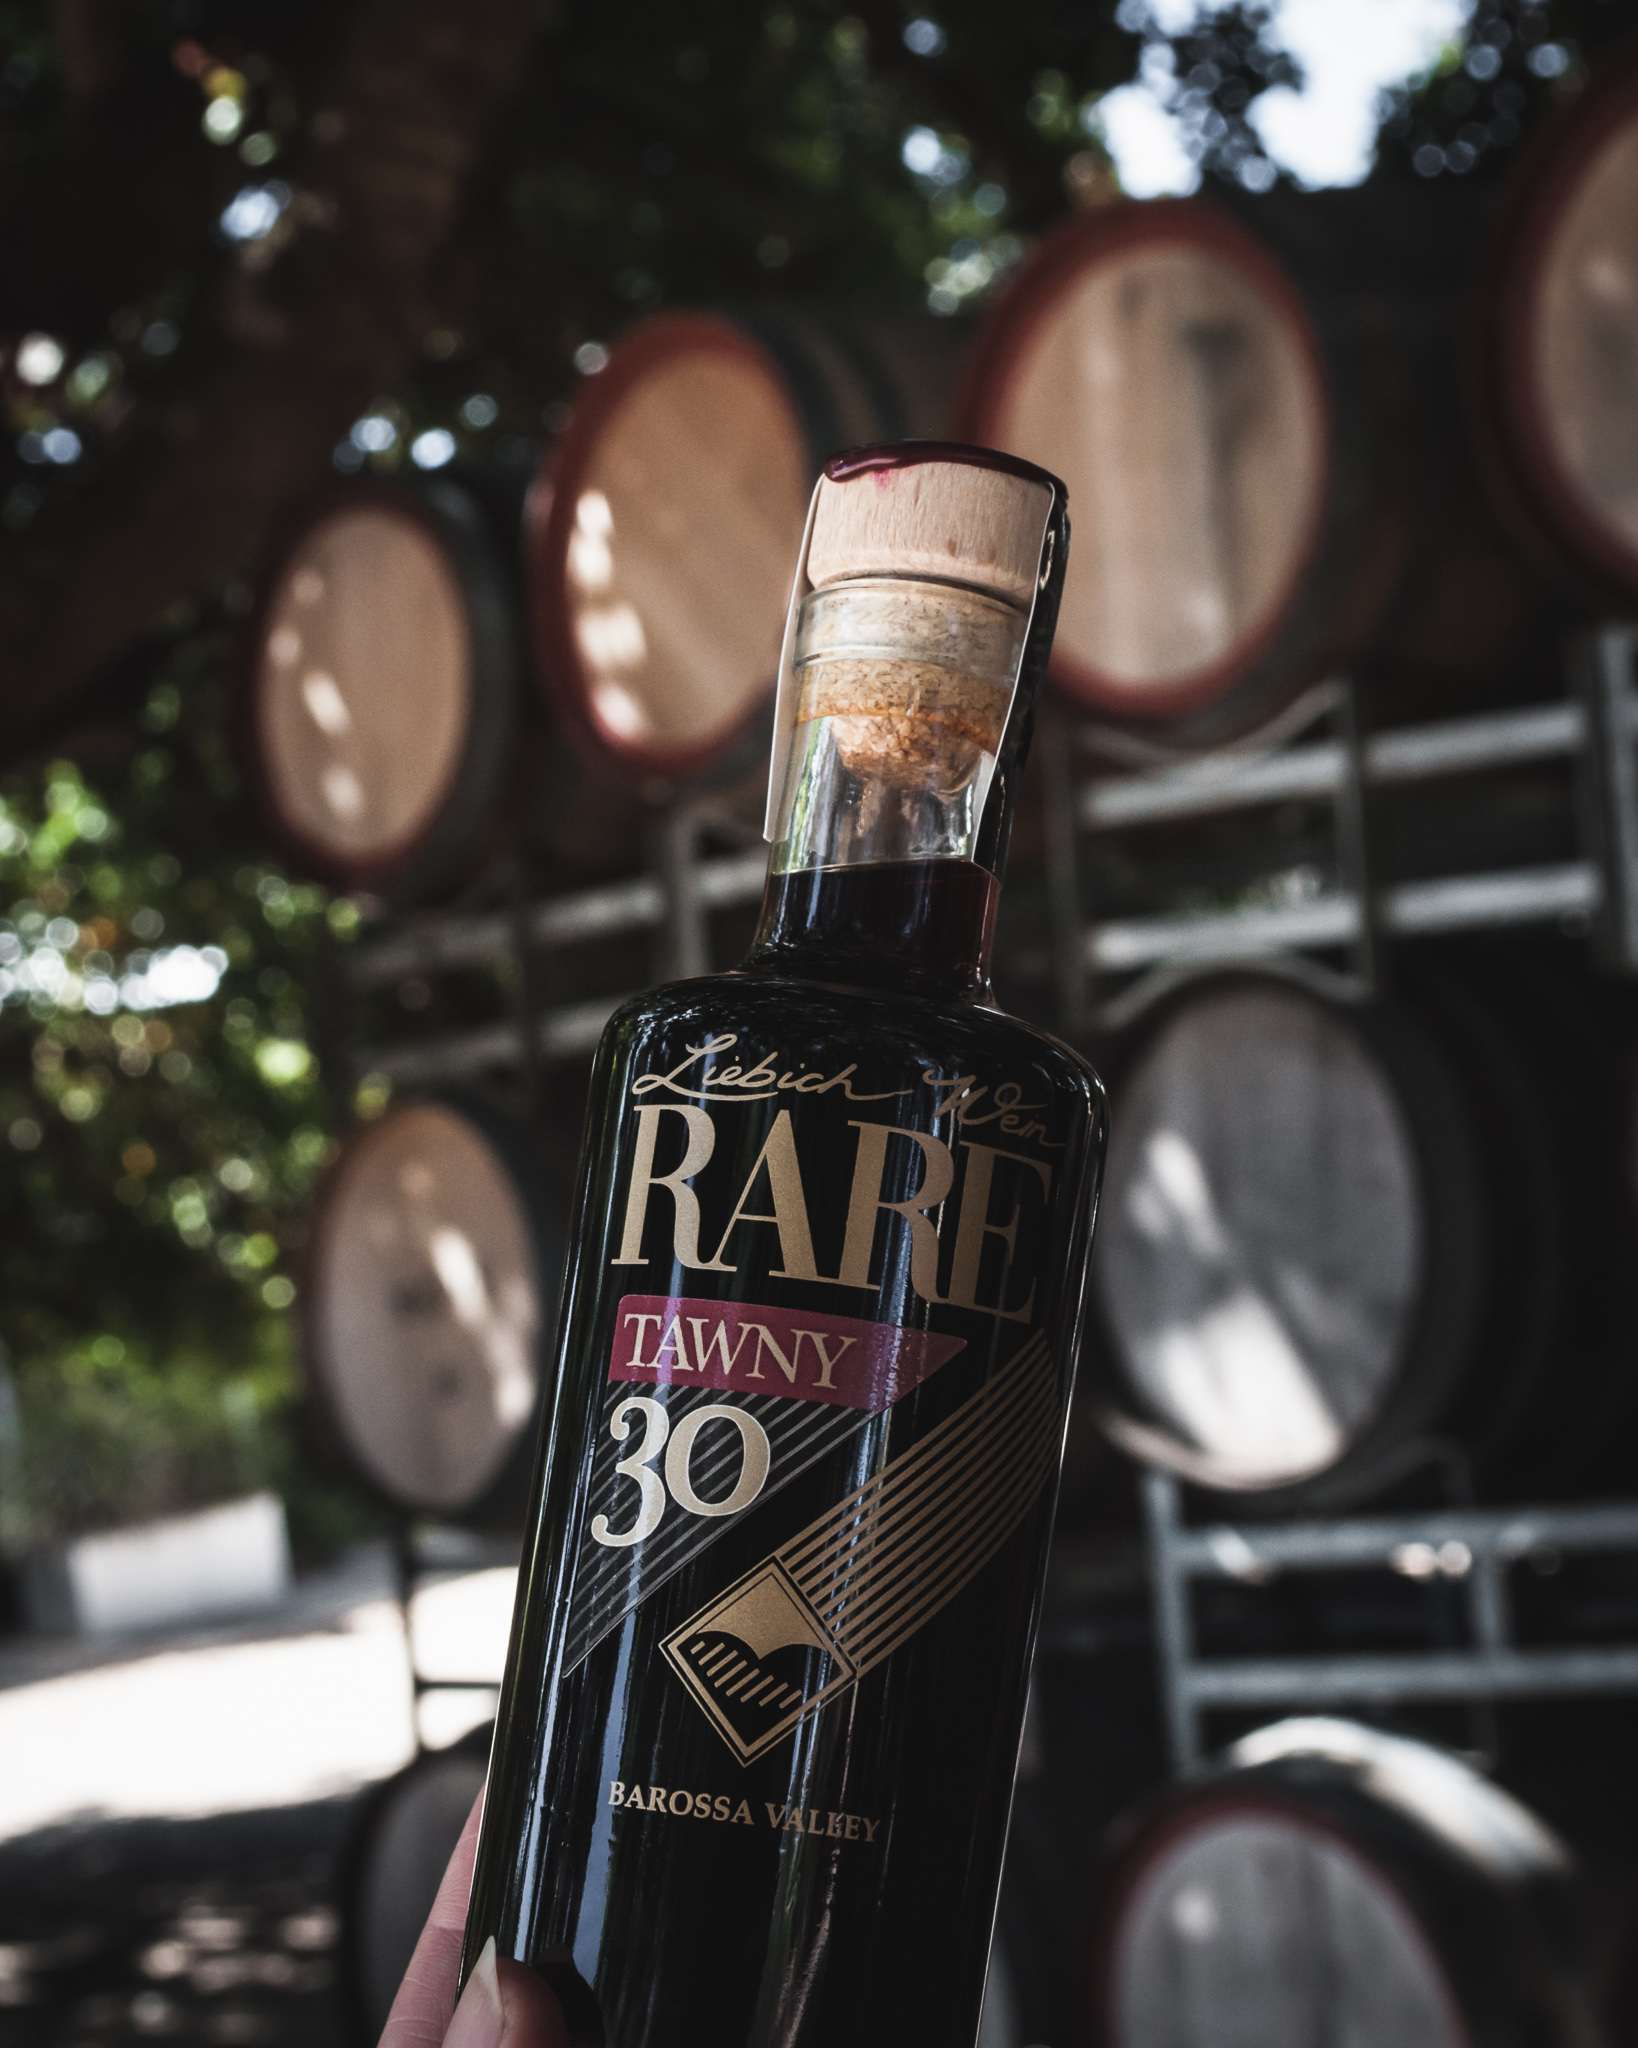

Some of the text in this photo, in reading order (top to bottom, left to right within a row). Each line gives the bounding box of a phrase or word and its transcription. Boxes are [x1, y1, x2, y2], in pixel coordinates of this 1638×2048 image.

[632, 1033, 1067, 1148] Liebich Wein
[611, 1103, 1053, 1325] RARE
[623, 1313, 857, 1389] TAWNY
[591, 1396, 771, 1548] 30
[608, 1781, 881, 1842] BAROSSA VALLEY
